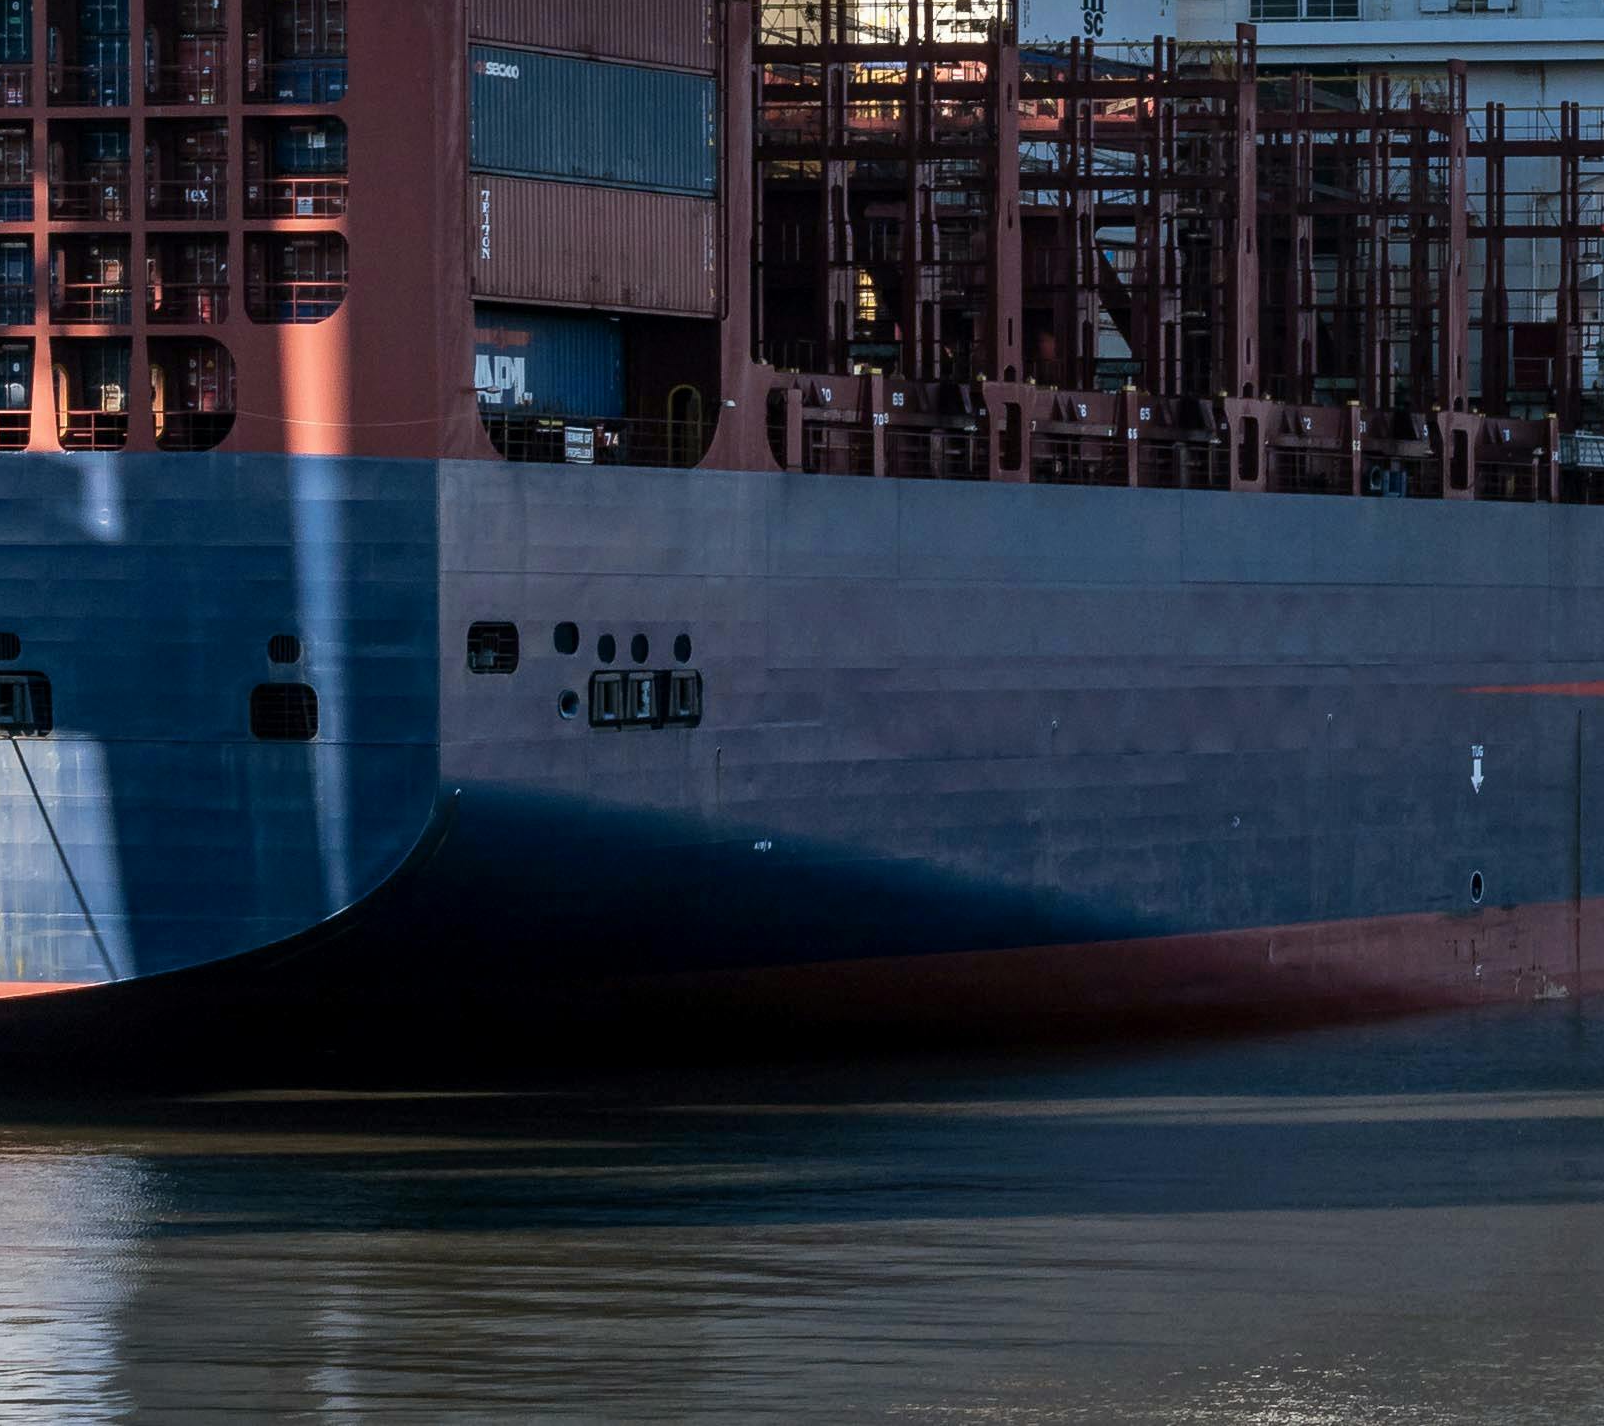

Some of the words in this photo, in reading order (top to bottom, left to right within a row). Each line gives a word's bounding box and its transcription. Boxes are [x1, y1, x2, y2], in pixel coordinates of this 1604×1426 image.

[185, 187, 209, 203] tex
[480, 189, 492, 260] TRITON
[474, 354, 533, 406] APL
[892, 392, 905, 406] 69
[1140, 408, 1150, 421] 65
[1471, 745, 1484, 757] TUG
